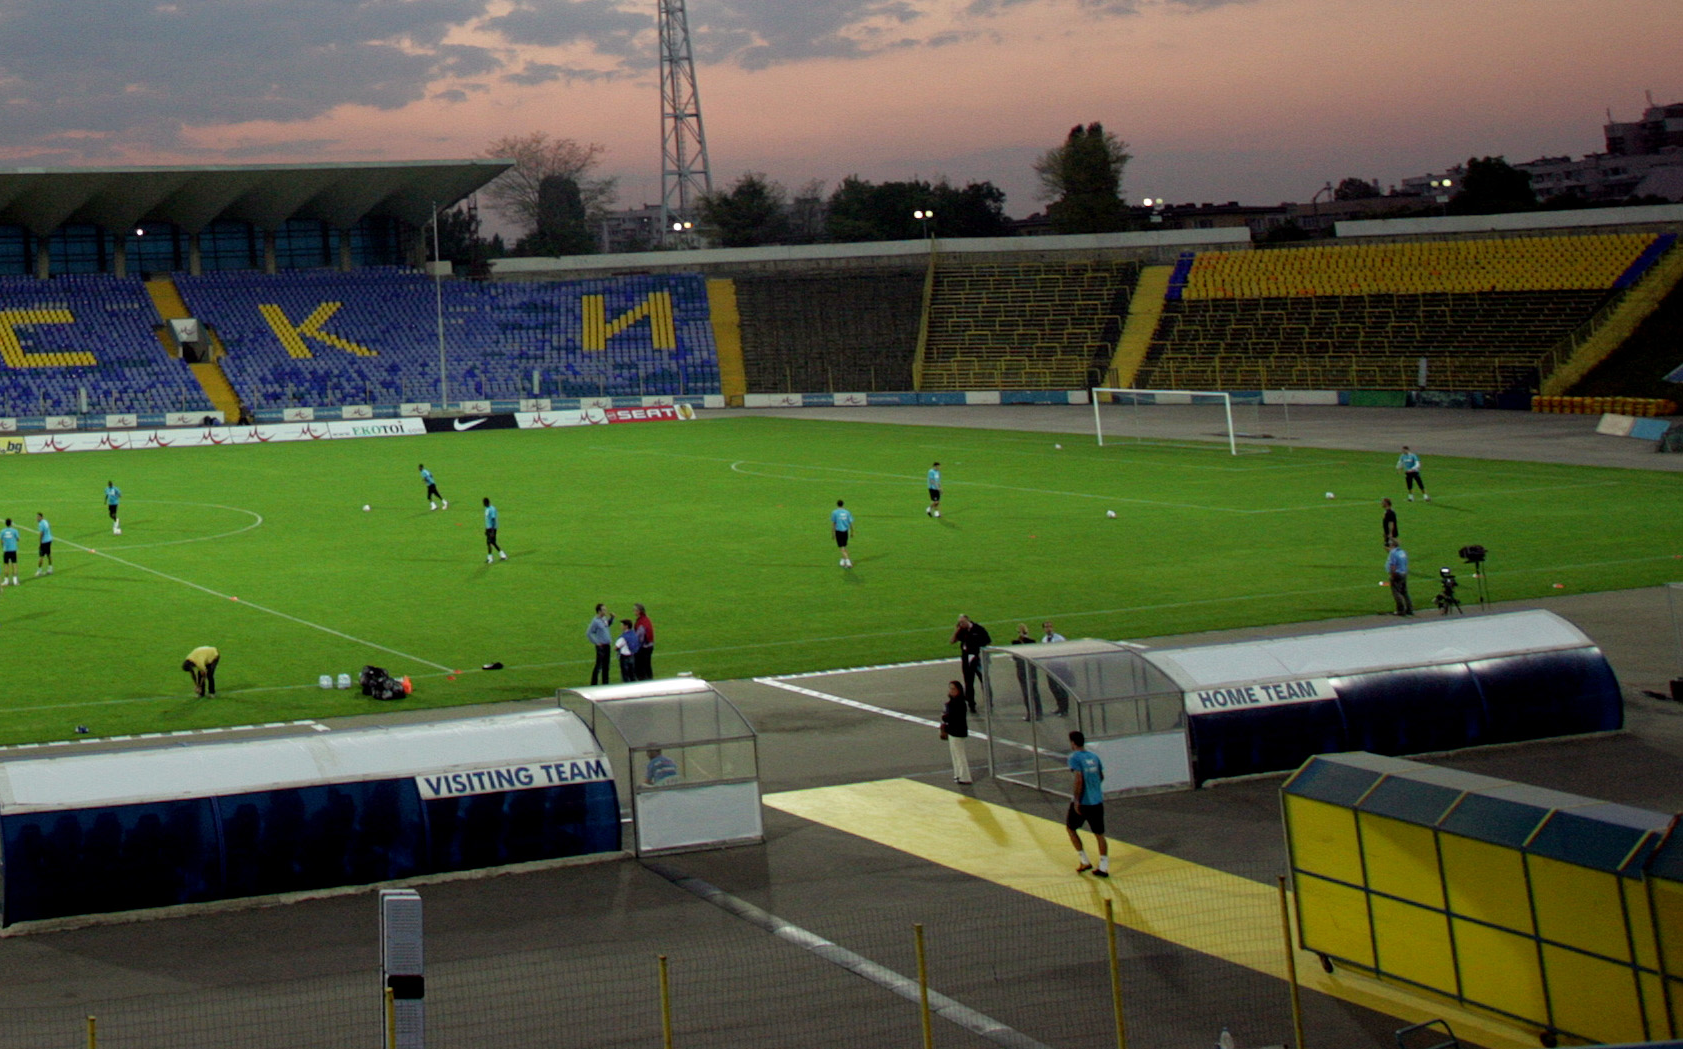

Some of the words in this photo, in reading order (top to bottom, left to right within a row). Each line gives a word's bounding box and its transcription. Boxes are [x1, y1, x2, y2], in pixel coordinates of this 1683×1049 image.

[617, 408, 674, 420] SEAT
[1198, 686, 1259, 709] HOME
[1261, 680, 1318, 702] TEAM
[424, 766, 534, 796] VISITING
[540, 759, 608, 784] TEAM
